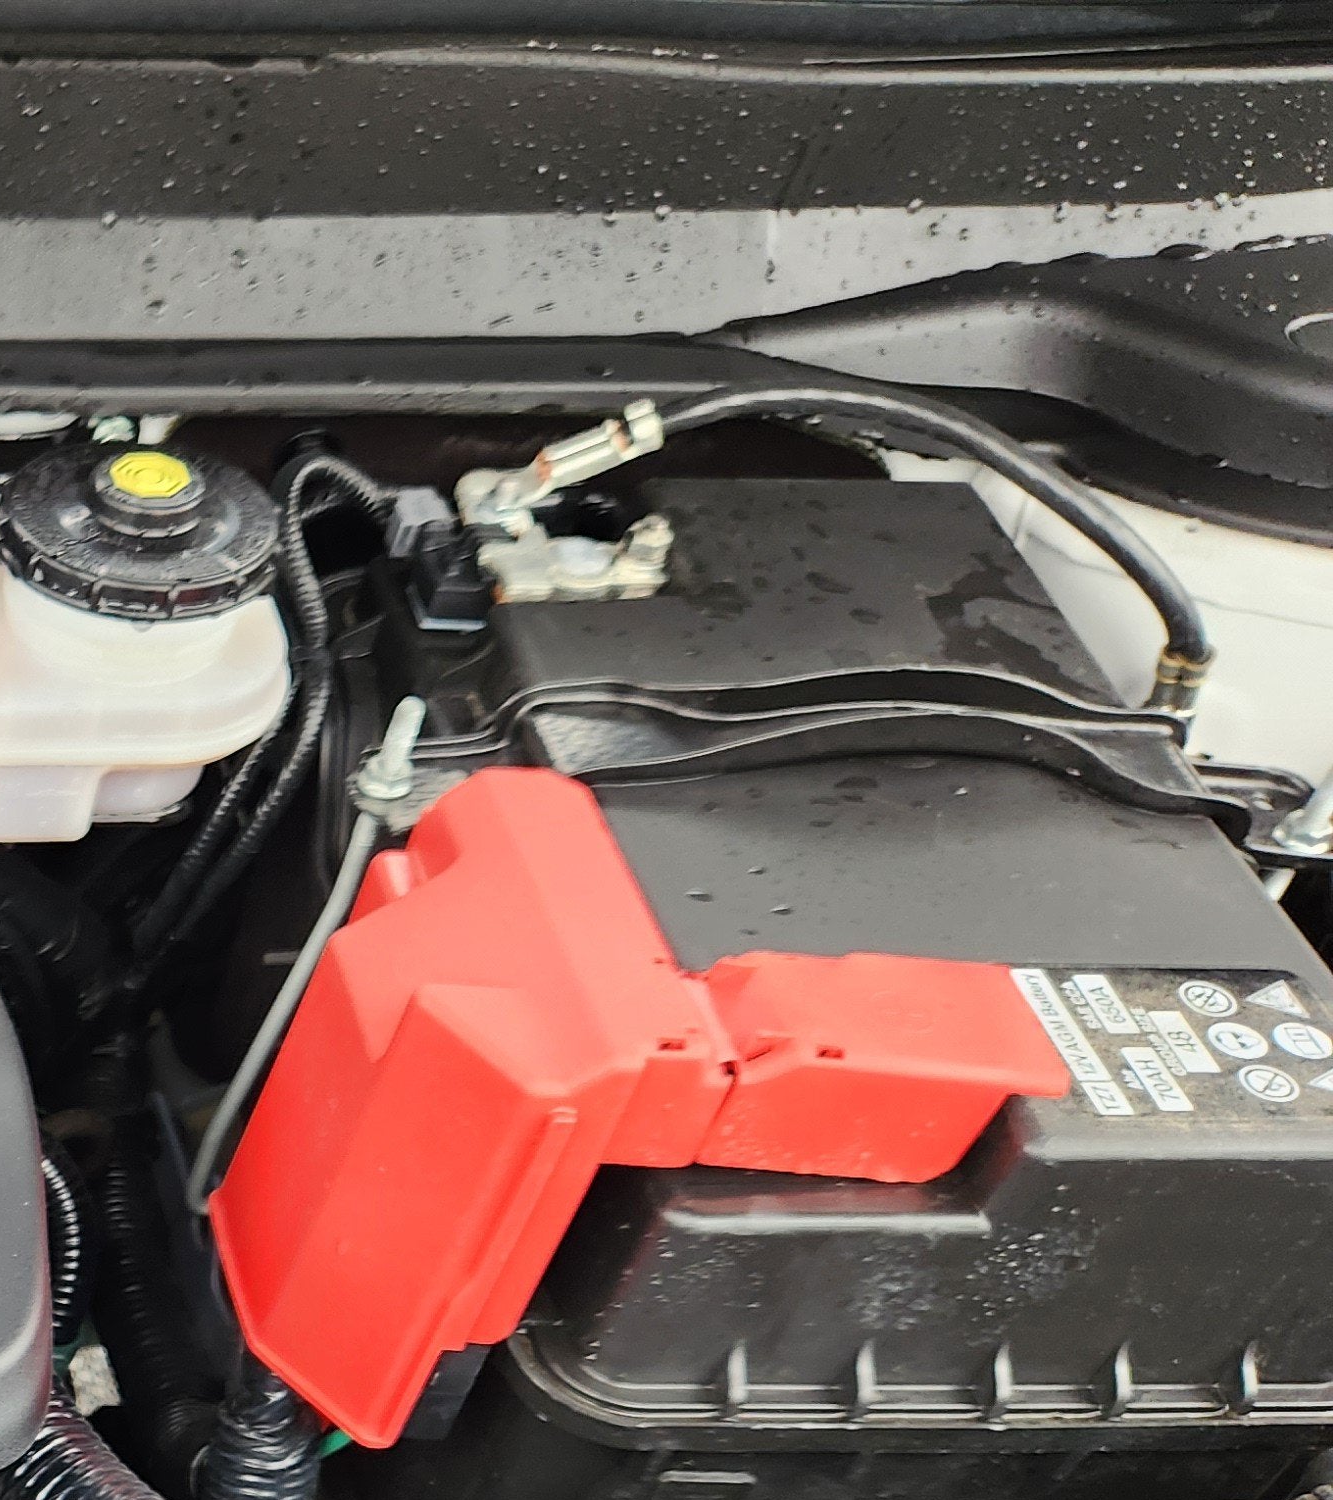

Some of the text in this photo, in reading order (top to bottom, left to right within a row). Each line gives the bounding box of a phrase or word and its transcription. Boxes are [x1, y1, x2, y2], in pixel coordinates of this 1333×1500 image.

[1022, 974, 1059, 1018] Battery
[1090, 986, 1127, 1025] 650A
[1048, 1018, 1079, 1055] AGM
[1146, 1033, 1187, 1077] GROUP
[1167, 1030, 1196, 1053] 48
[1135, 1058, 1180, 1101] 70AH
